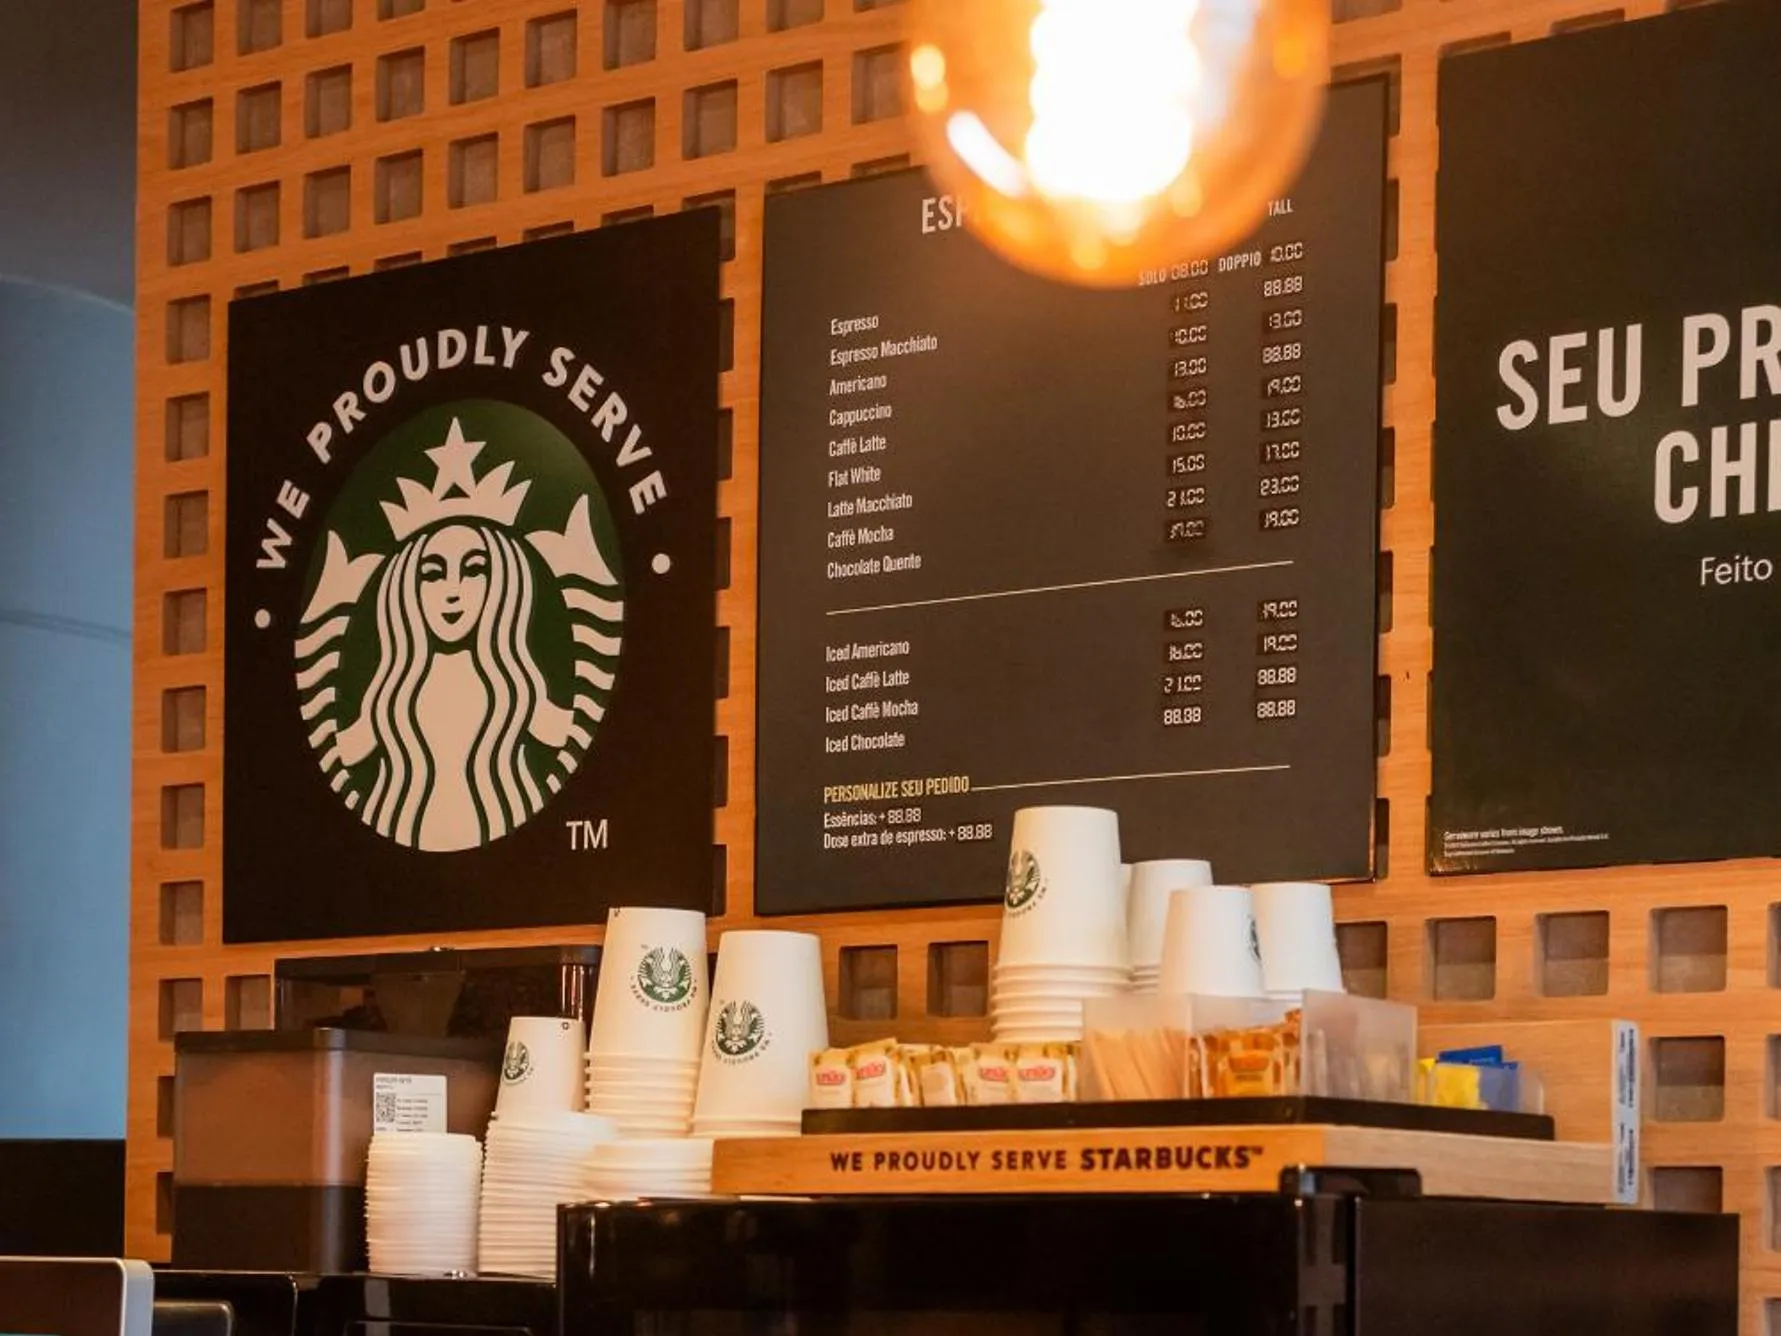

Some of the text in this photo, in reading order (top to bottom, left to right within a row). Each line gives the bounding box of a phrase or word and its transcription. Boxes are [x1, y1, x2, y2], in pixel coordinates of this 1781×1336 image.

[1268, 199, 1293, 216] TALL
[1218, 251, 1262, 273] DOPPIO
[1138, 270, 1167, 286] SOLO
[1264, 276, 1303, 297] 88.88
[830, 315, 879, 337] Espresso
[830, 335, 938, 367] Espresso Macchiato
[1262, 343, 1302, 364] 88.88
[829, 375, 887, 396] Americano
[1496, 323, 1643, 431] SEU
[829, 403, 892, 427] Cappuccino
[1266, 408, 1301, 428] 13.00
[257, 325, 667, 571] WE PROUDLY SERVE
[859, 435, 887, 453] Latte
[828, 466, 882, 488] Flat White
[827, 492, 913, 518] Latte Macchiato
[858, 525, 894, 544] Mocha
[827, 552, 922, 579] Chocolate Quente
[1700, 555, 1774, 586] Feito
[826, 641, 910, 662] Iced Americano
[826, 674, 849, 693] Iced
[882, 669, 910, 687] Latte
[1257, 667, 1297, 685] 88.88
[826, 705, 849, 723] Iced
[882, 700, 918, 717] Mocha
[1257, 699, 1296, 718] 88.88
[826, 731, 905, 753] Iced Chocolate
[823, 776, 970, 804] PERSONALIZE SEU PEDIDO
[887, 808, 922, 824] 88.88
[566, 819, 608, 850] TM
[823, 833, 849, 849] Dose
[851, 831, 877, 847] extra
[880, 829, 893, 845] de
[895, 827, 947, 847] espresso:
[957, 824, 993, 841] 88.88
[830, 1152, 863, 1171] WE
[873, 1151, 981, 1171] PROUDLY
[991, 1150, 1067, 1170] SERVE
